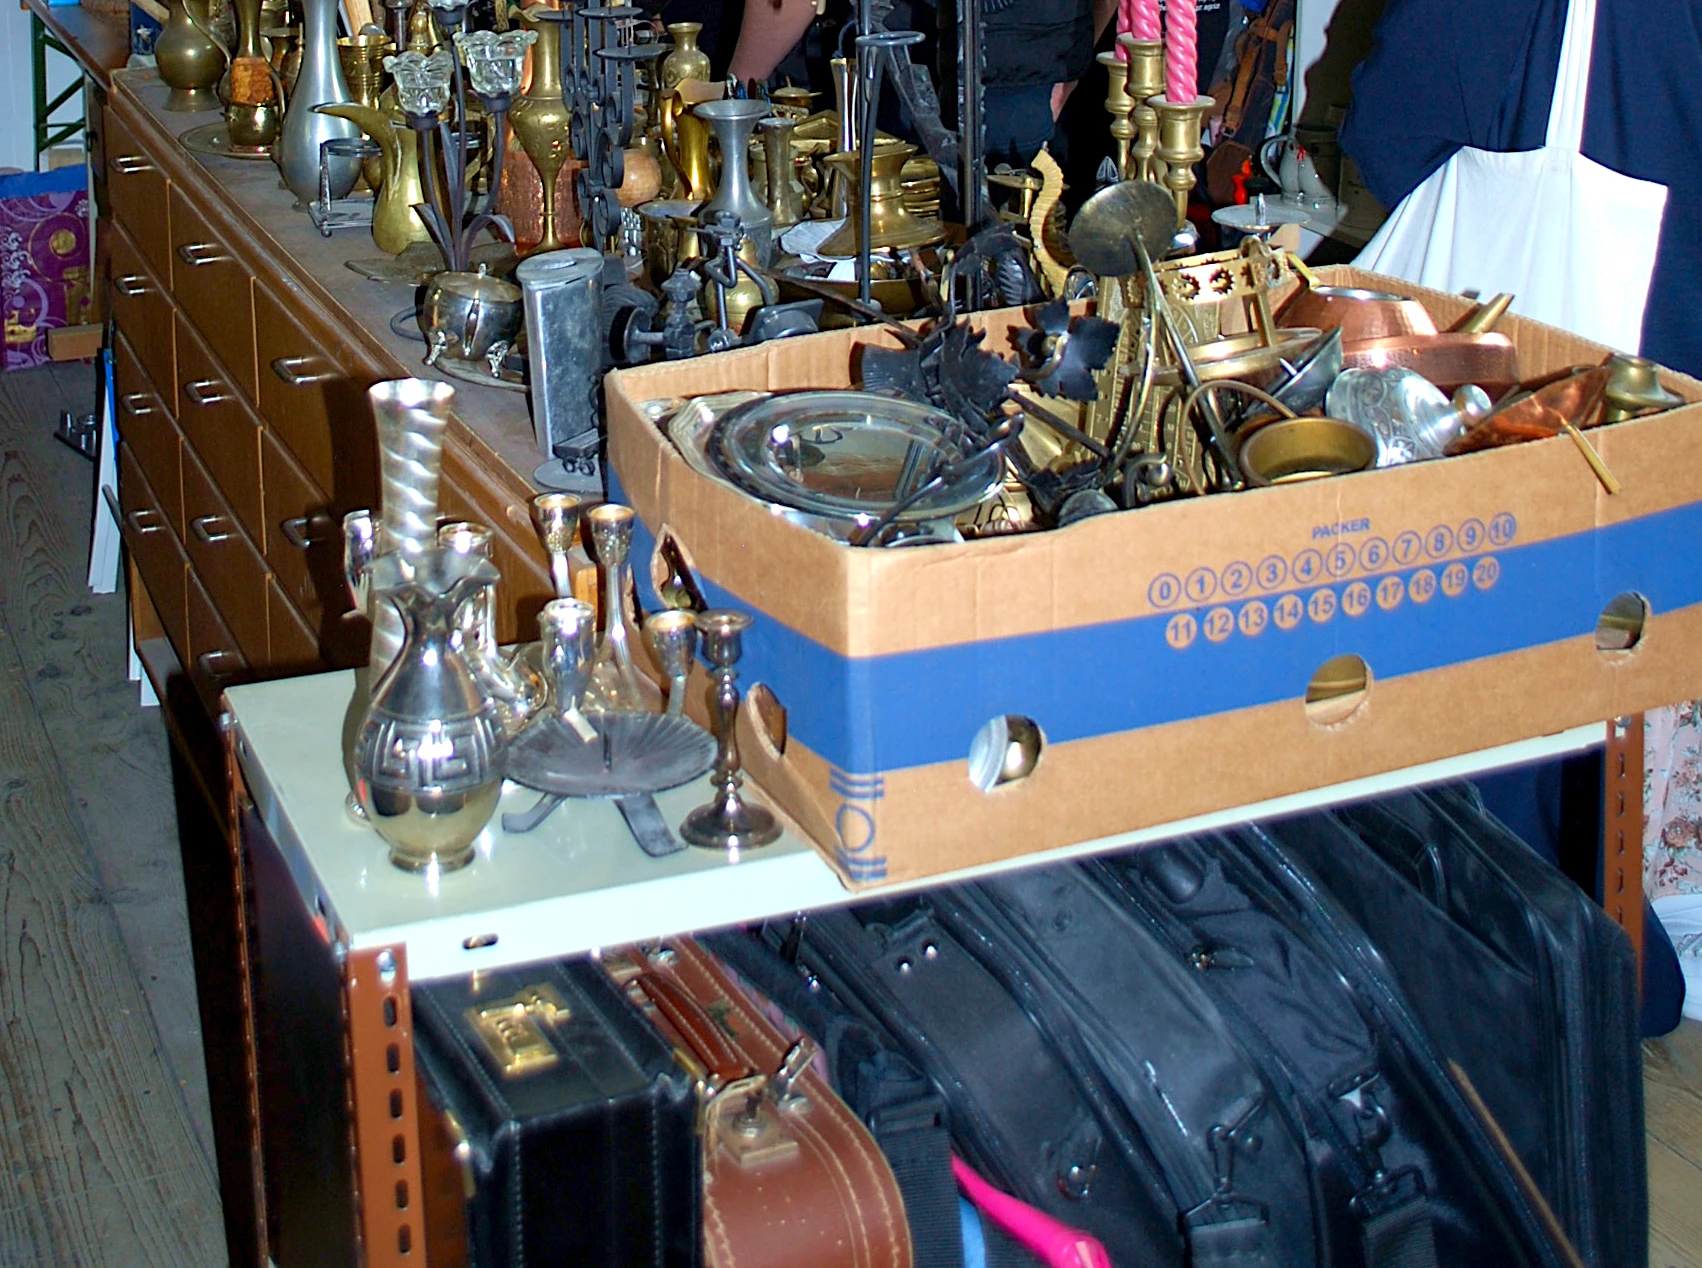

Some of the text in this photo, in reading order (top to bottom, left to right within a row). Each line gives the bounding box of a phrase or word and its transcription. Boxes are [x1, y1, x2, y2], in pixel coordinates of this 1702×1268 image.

[1159, 519, 1515, 600] 0 1 2 3 4 5 6 7 8 9 10
[1312, 518, 1371, 540] PACKER
[1171, 562, 1497, 642] 11 12 13 14 15 16 17 18 19 20
